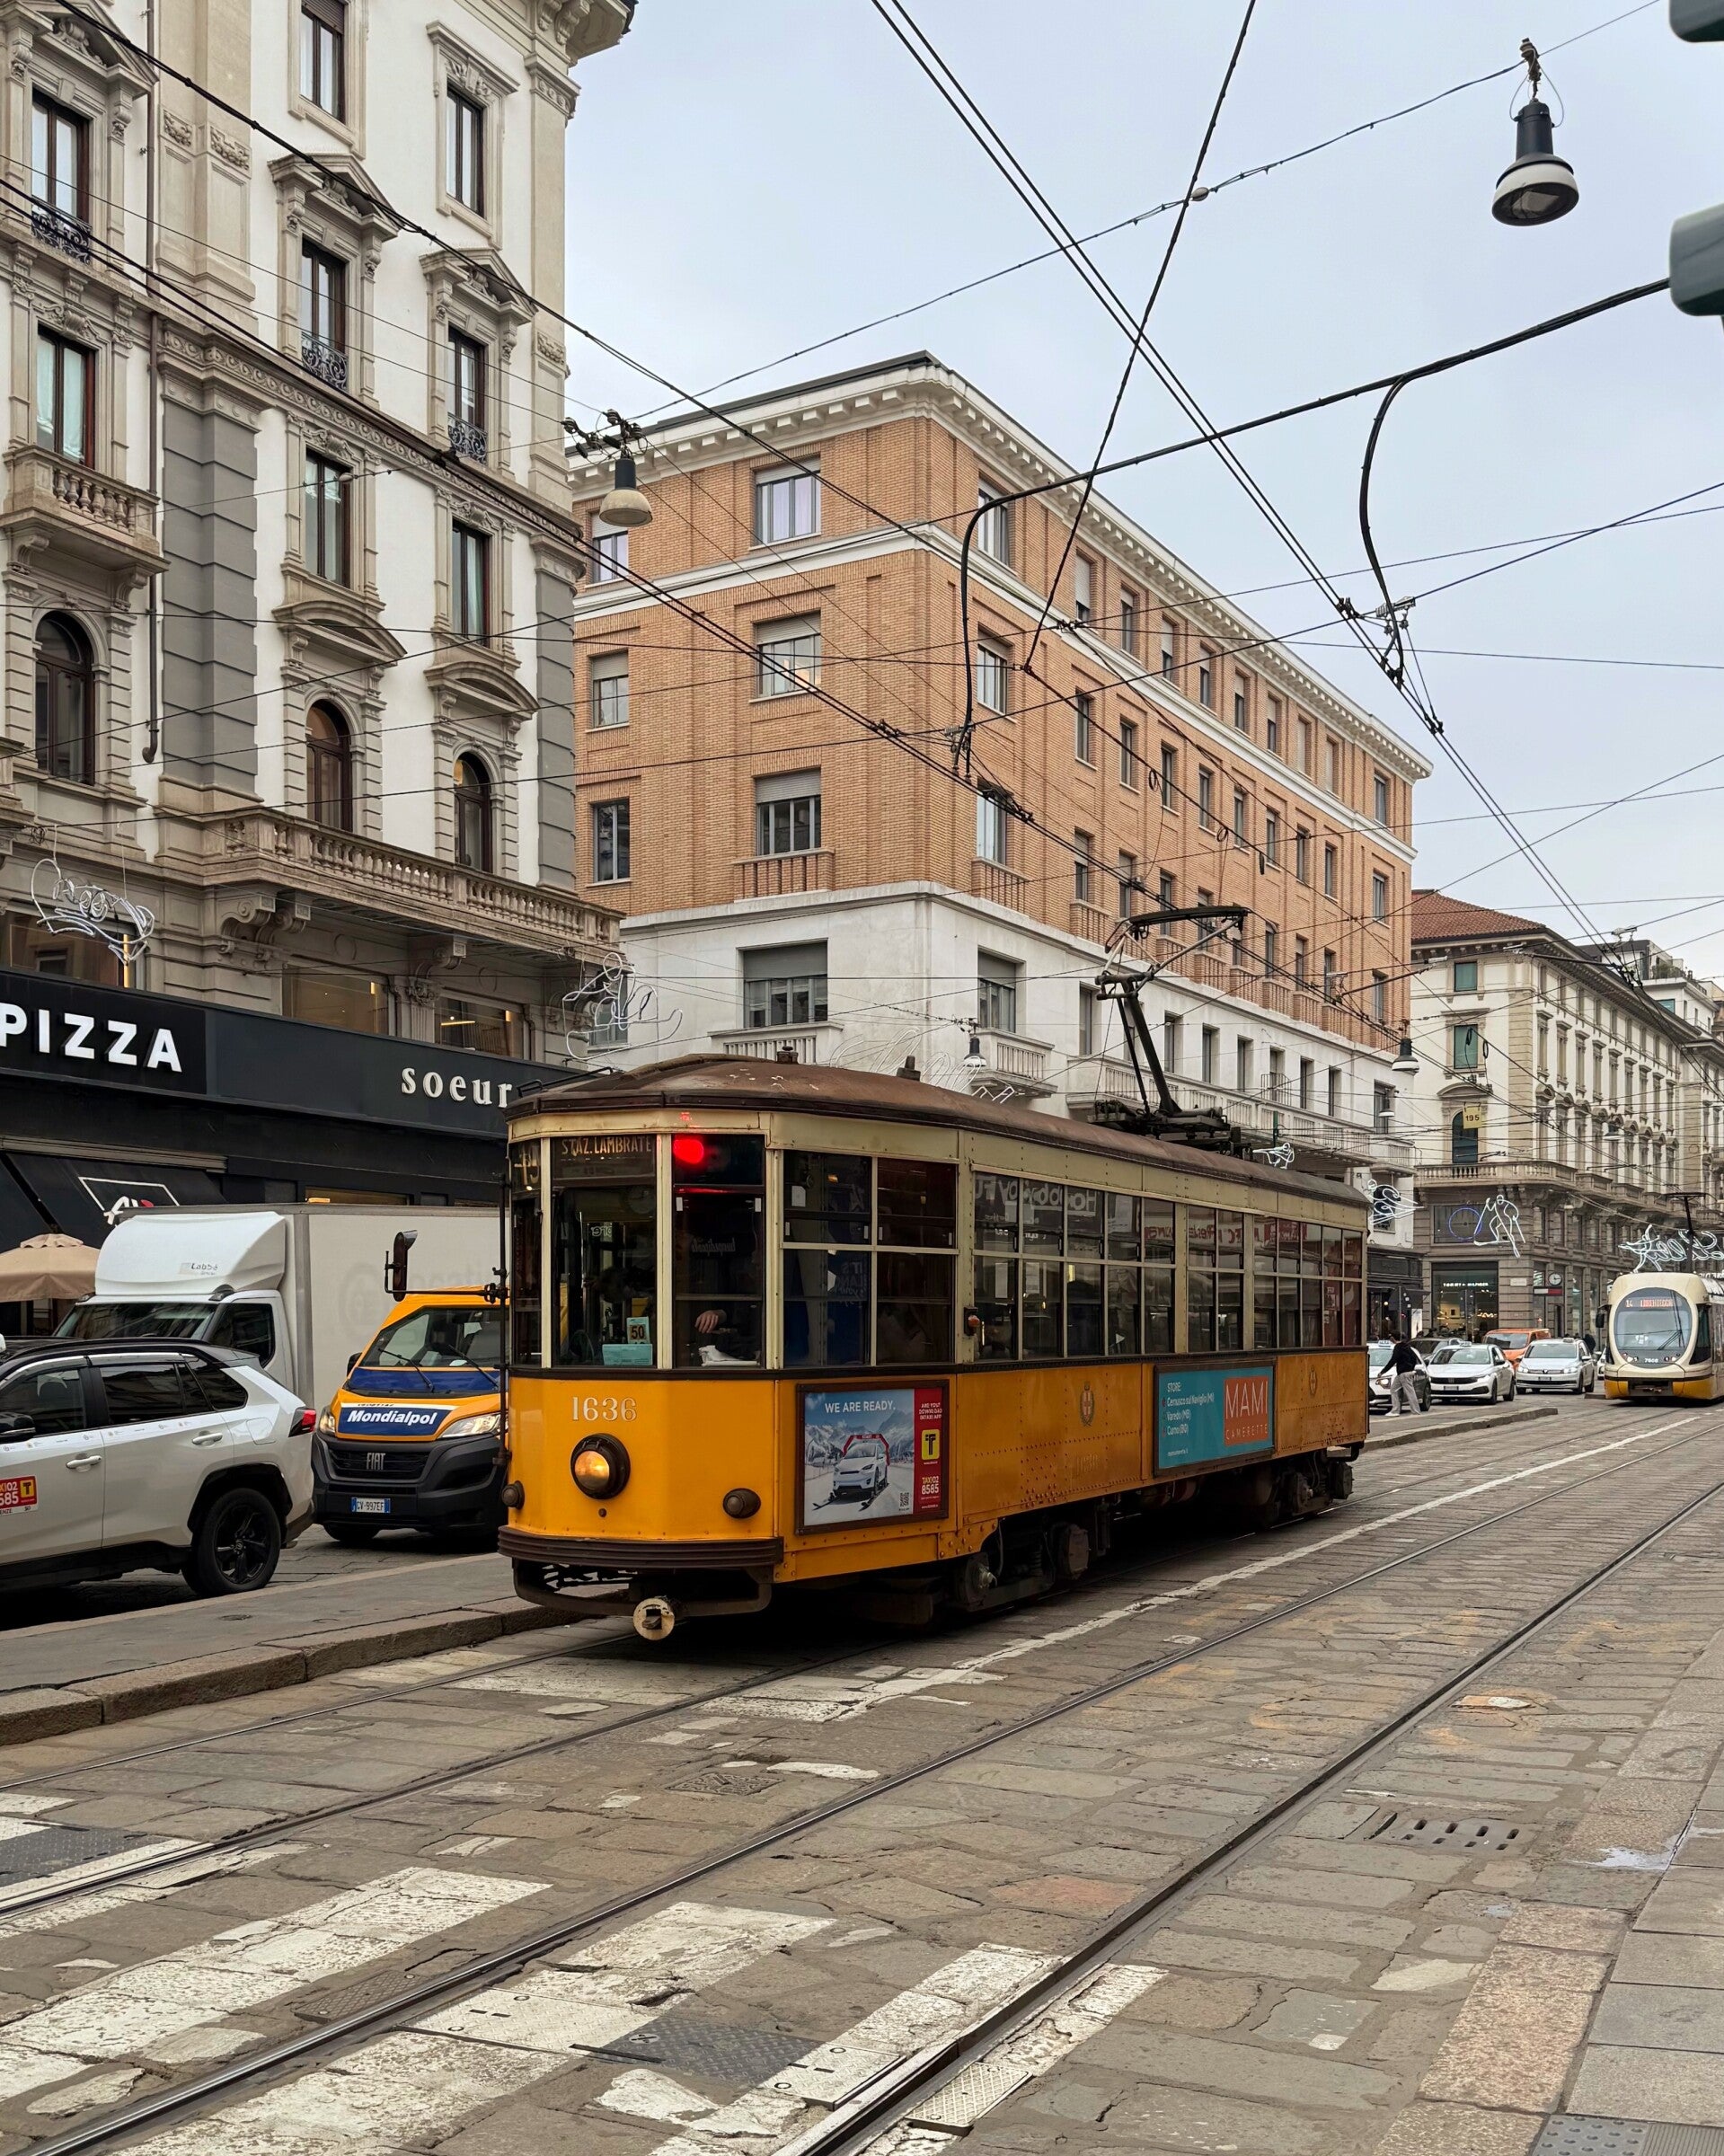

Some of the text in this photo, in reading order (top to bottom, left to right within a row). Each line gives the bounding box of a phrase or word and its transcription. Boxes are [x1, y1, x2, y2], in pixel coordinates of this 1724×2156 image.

[0, 1002, 182, 1073] PIZZA
[402, 1067, 513, 1109] soeur
[1465, 1114, 1480, 1122] 195
[595, 1135, 652, 1154] LAMBRATE
[631, 1325, 645, 1339] 50
[572, 1396, 637, 1421] 1636
[825, 1401, 897, 1413] WE ARE READY.
[1225, 1381, 1269, 1418] MAMI
[347, 1409, 438, 1426] Mondialpol
[367, 1453, 385, 1471] FIAT
[921, 1484, 940, 1495] 8585
